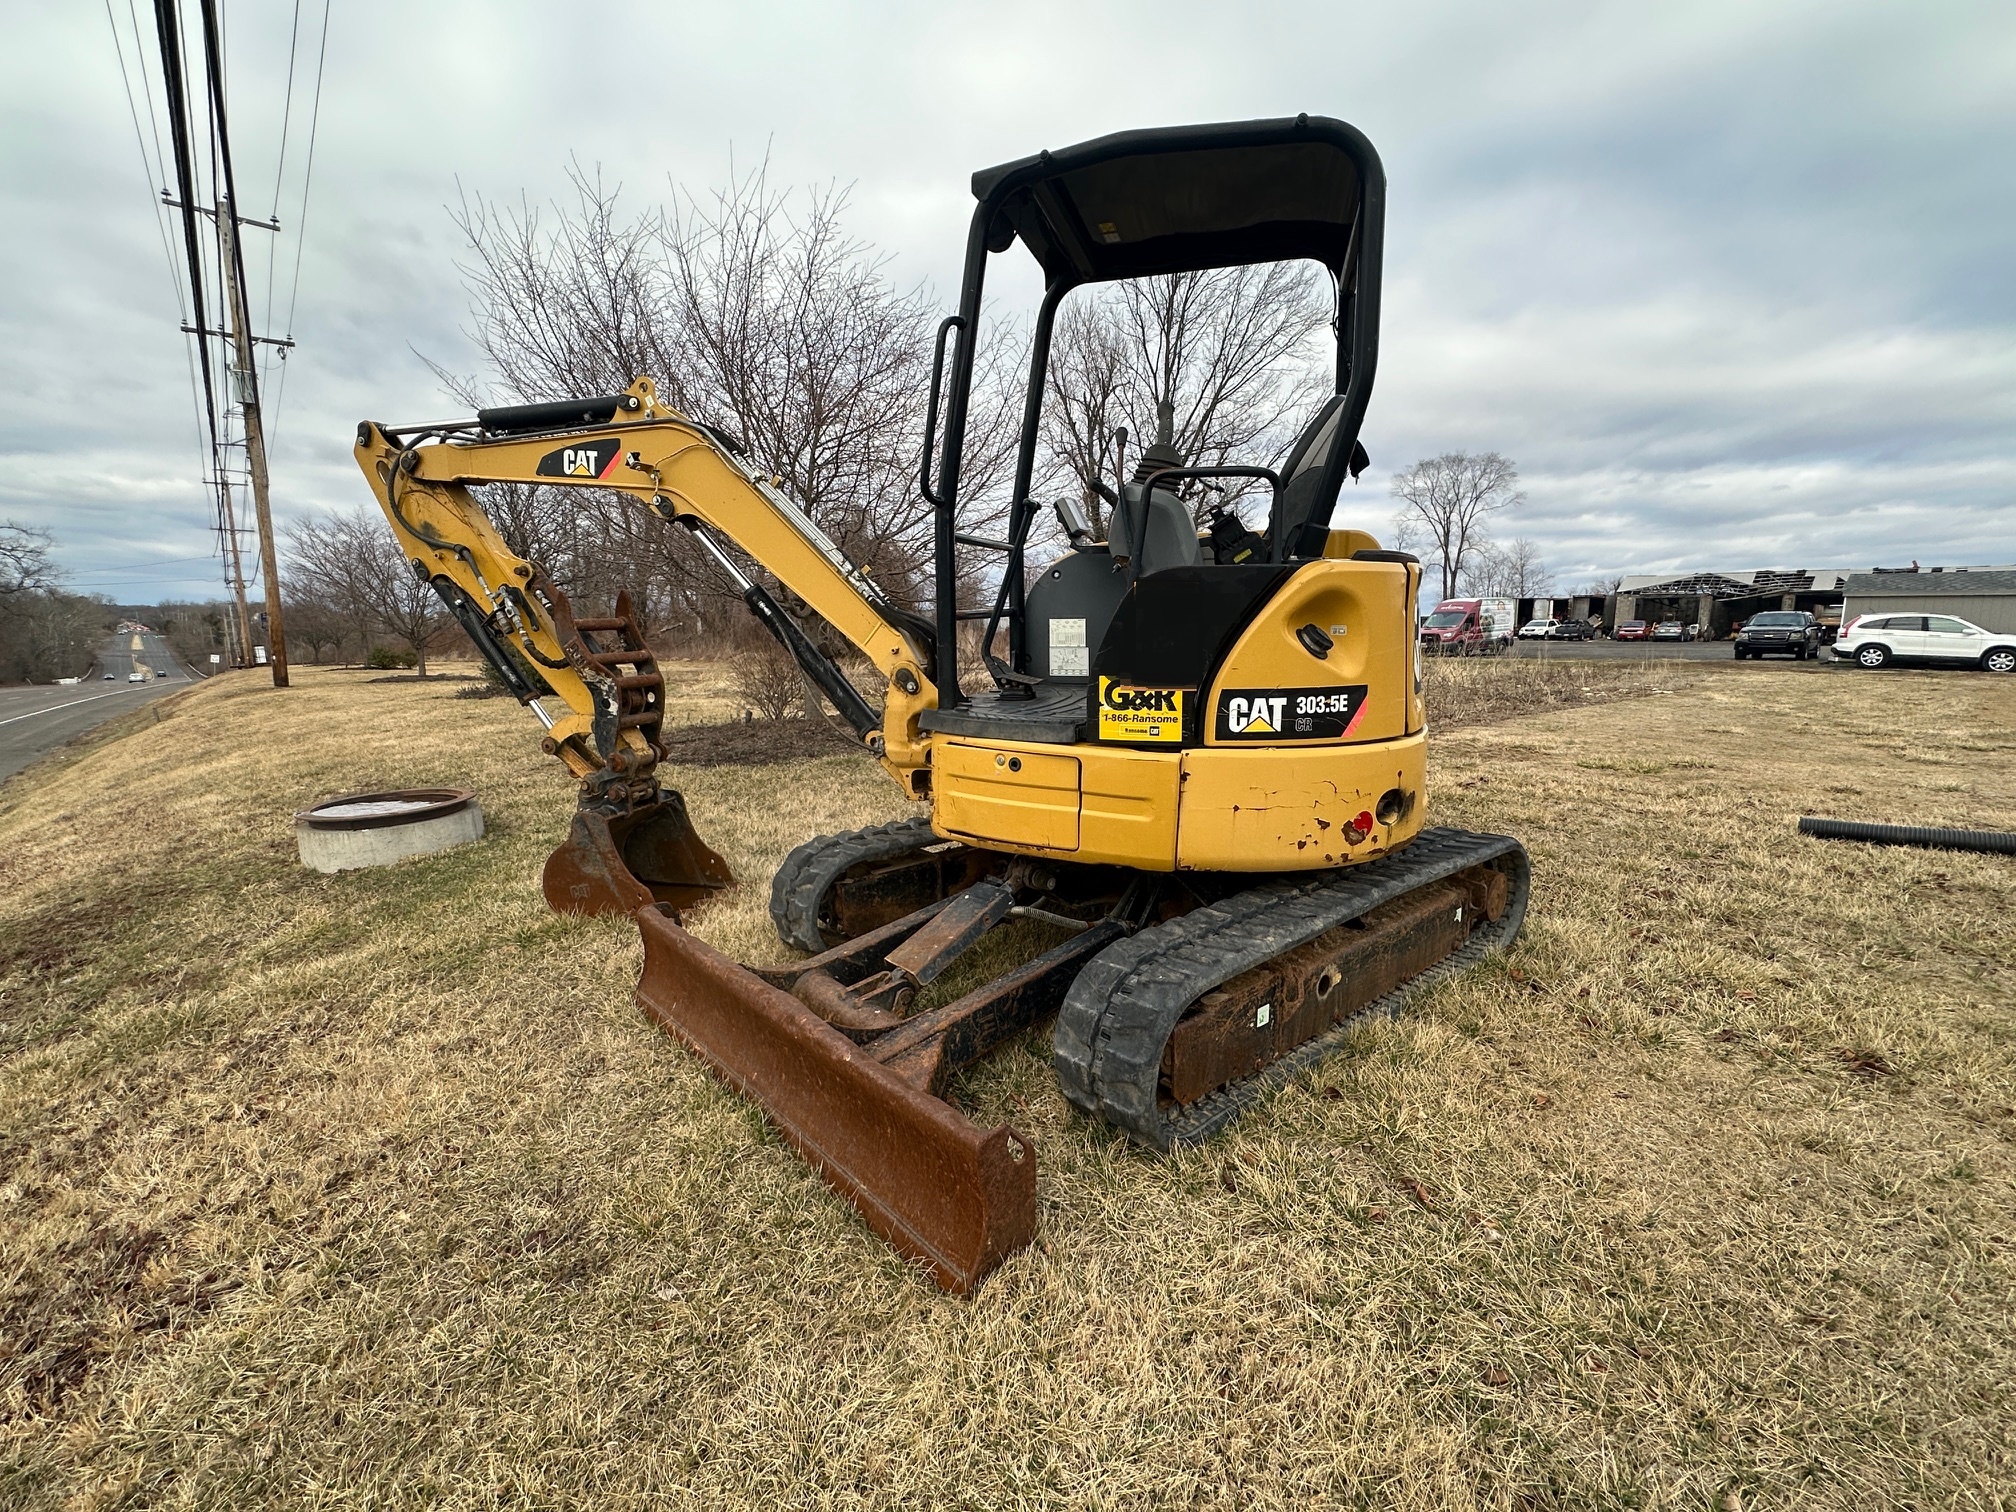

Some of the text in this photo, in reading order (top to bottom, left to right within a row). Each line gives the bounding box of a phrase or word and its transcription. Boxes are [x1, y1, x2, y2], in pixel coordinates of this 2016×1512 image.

[563, 449, 598, 477] CAT
[1103, 713, 1179, 723] 1-866-Ransome
[1228, 694, 1349, 733] CAT 303.5E
[1295, 717, 1313, 732] CR
